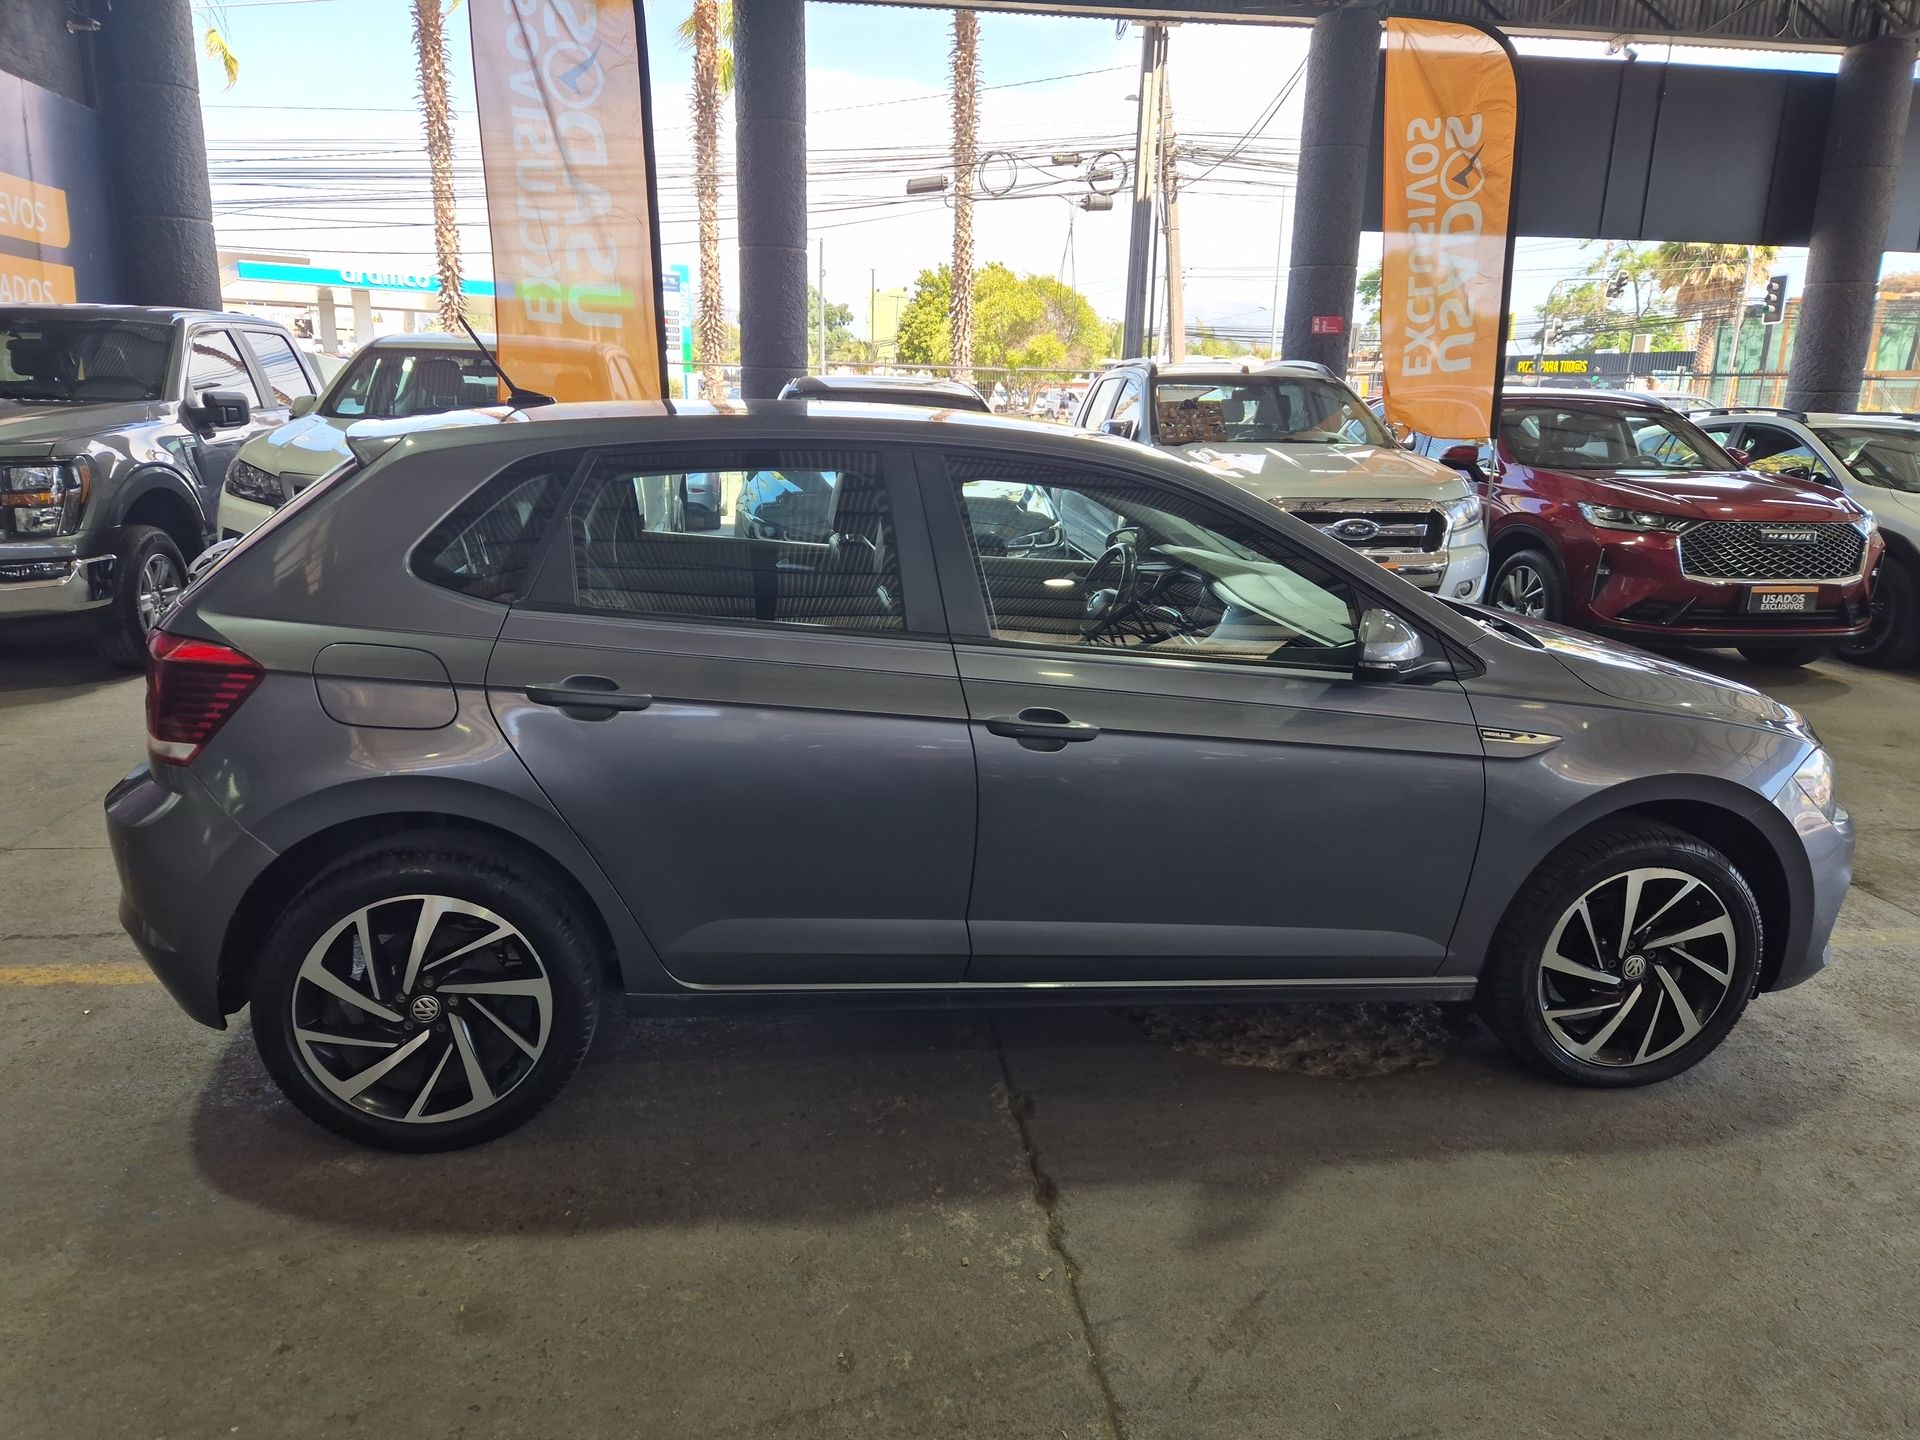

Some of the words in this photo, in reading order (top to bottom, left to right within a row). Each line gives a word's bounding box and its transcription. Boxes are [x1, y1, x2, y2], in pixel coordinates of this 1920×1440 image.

[340, 268, 431, 289] aramco
[1762, 594, 1806, 604] USADOS
[1761, 603, 1804, 611] EXCLUSIVOS
